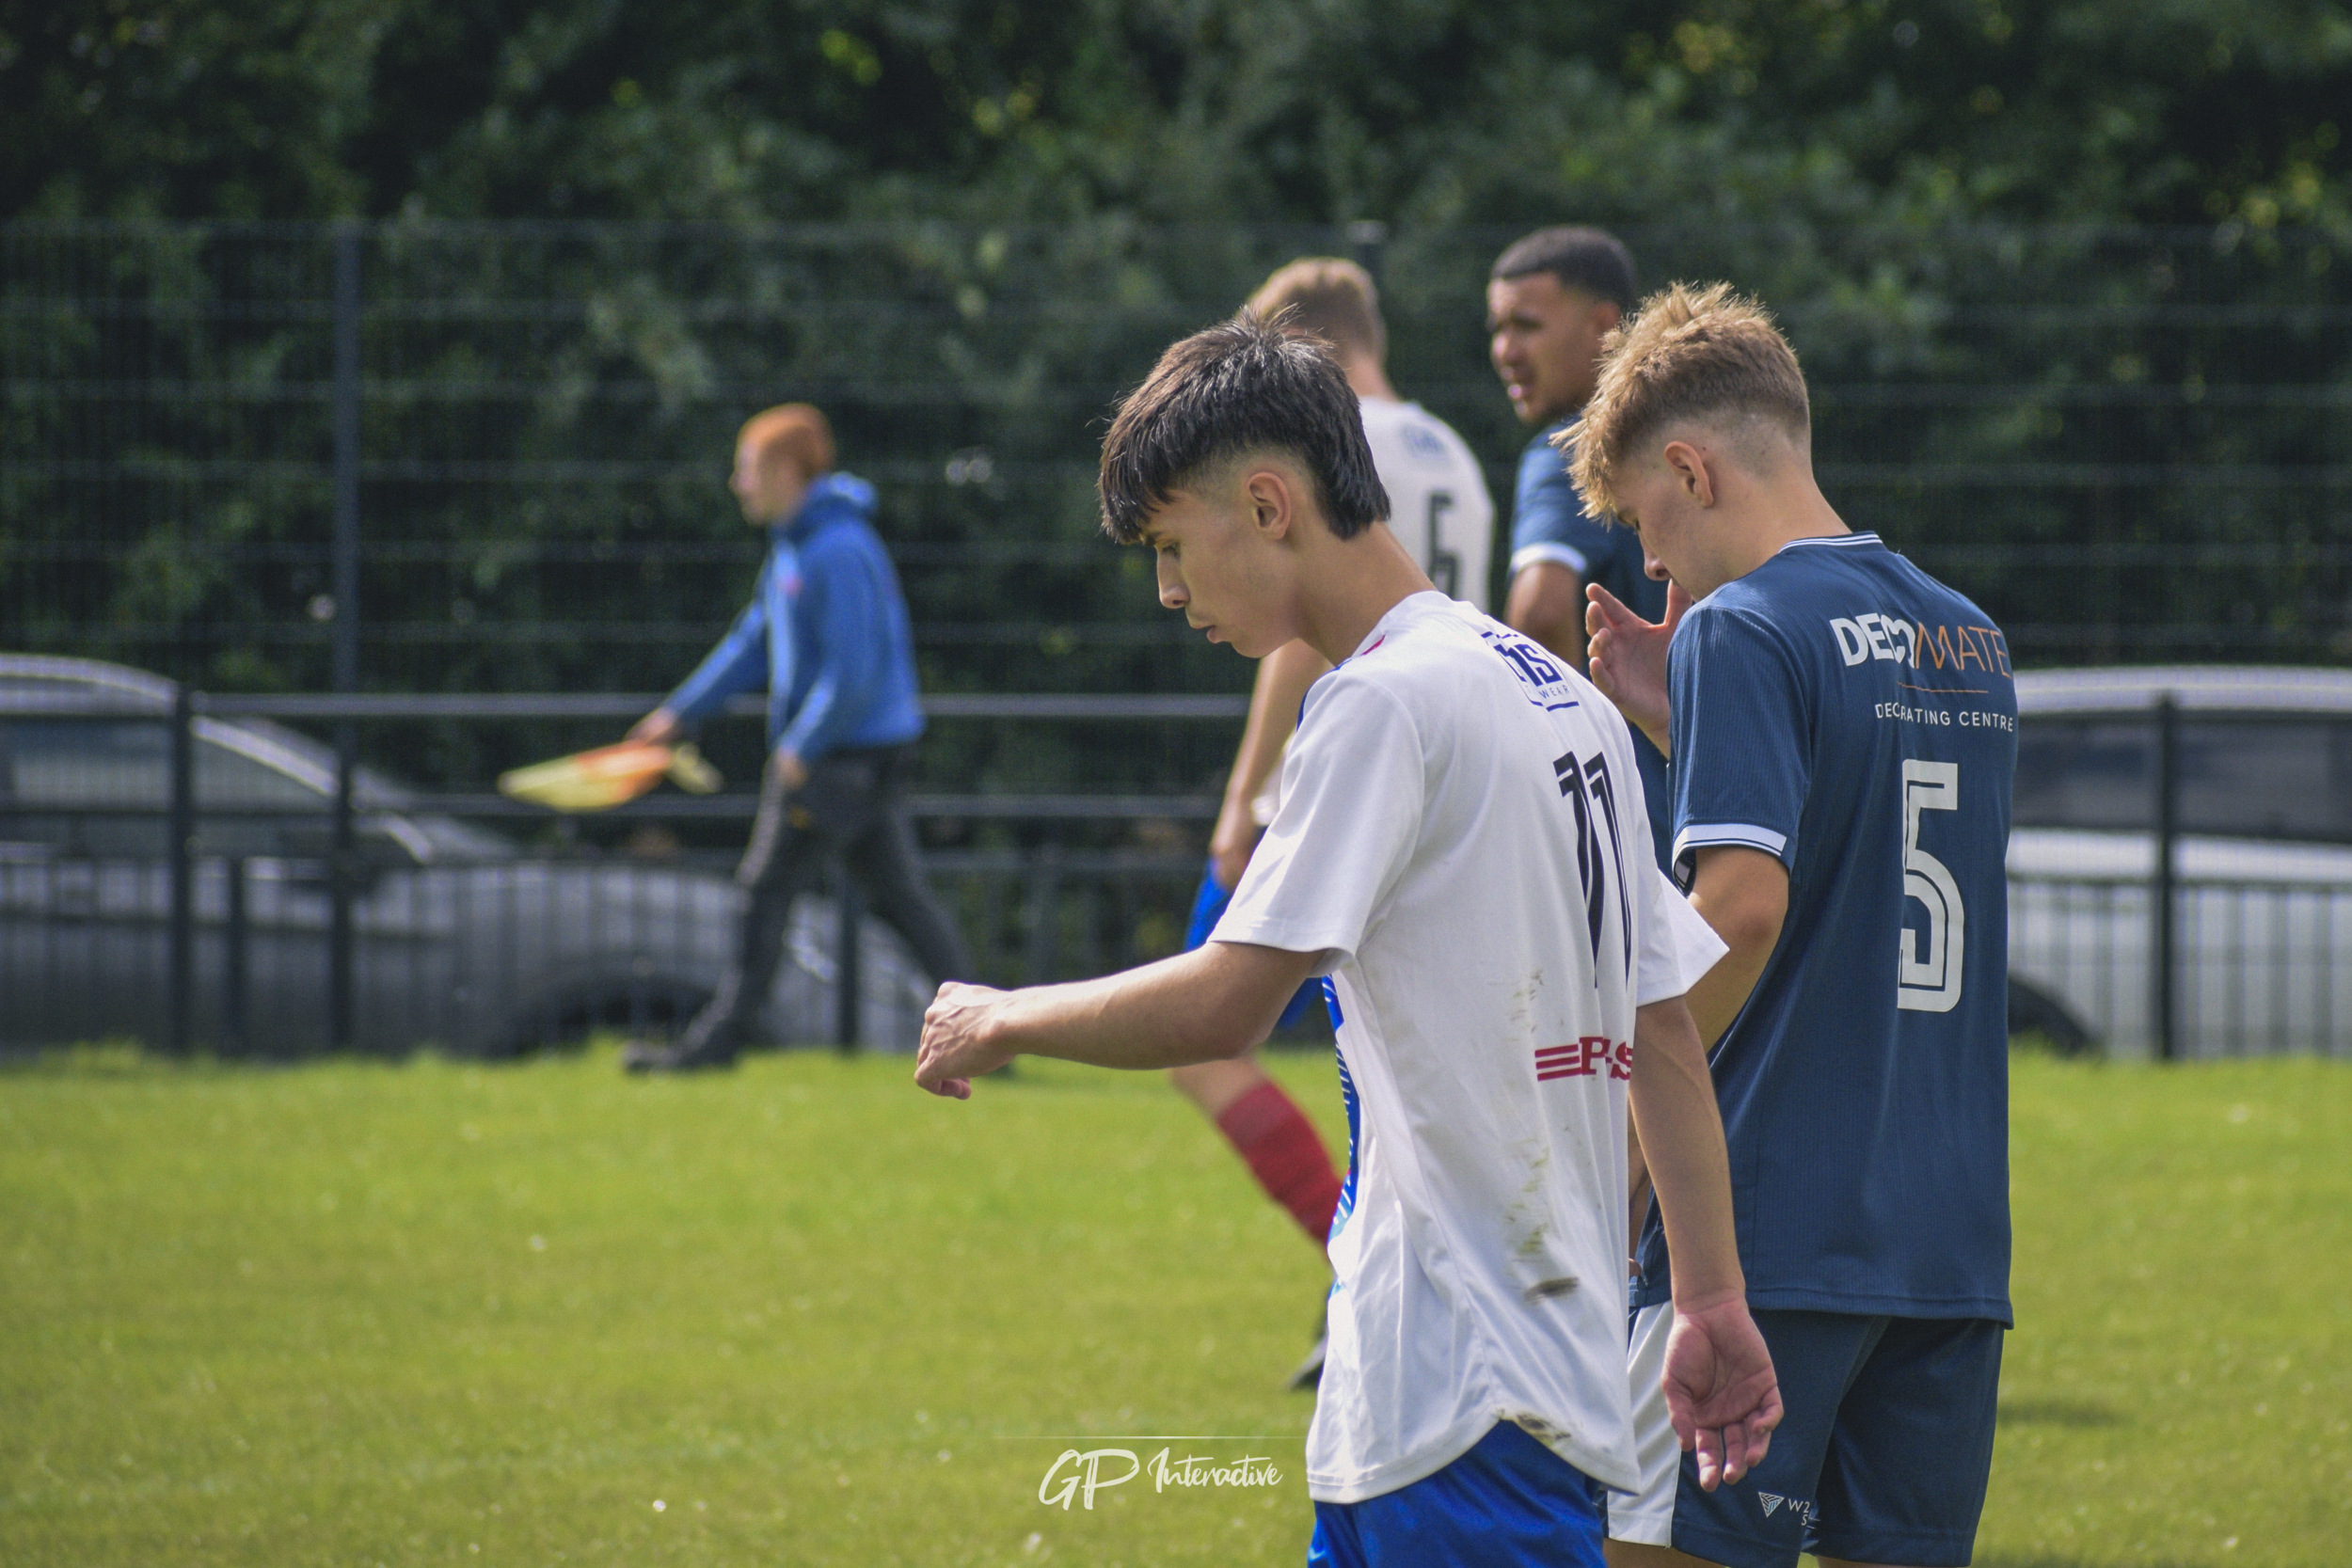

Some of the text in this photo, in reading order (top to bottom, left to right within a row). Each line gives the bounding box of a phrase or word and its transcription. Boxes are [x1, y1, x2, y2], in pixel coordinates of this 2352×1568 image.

[1875, 702, 2013, 732] DECRATING CENTRE
[1553, 751, 1631, 992] 11
[1898, 758, 1964, 1013] 5
